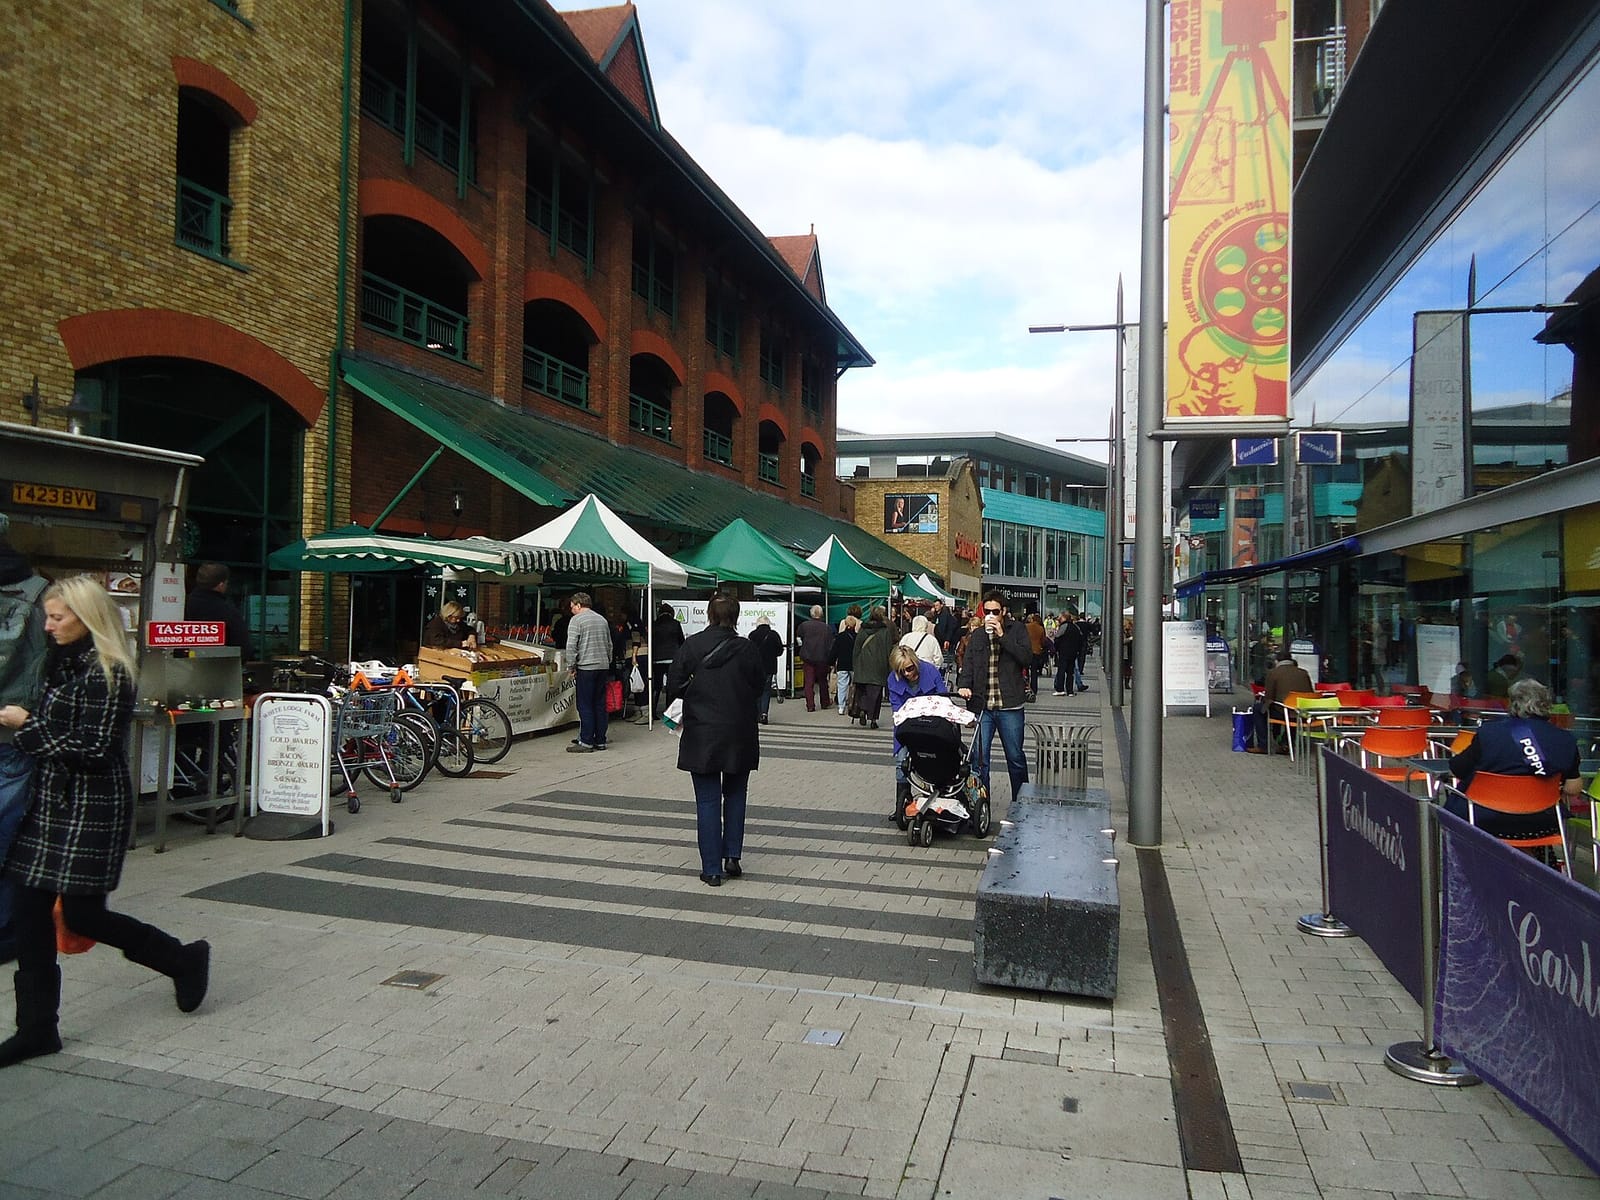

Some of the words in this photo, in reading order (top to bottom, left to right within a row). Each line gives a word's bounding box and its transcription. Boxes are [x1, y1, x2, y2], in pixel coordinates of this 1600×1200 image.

[15, 484, 58, 504] T423
[62, 490, 95, 507] BVV
[692, 606, 705, 615] fox
[744, 608, 776, 617] services
[155, 624, 219, 635] TASTERS
[292, 737, 319, 745] AWARDS
[1519, 737, 1547, 778] POPPY
[267, 759, 293, 767] BRONZE
[297, 760, 320, 769] AWARD
[273, 775, 308, 784] SAUSAGES
[1339, 778, 1407, 872] Carluccio's
[1508, 900, 1600, 1018] Carl
